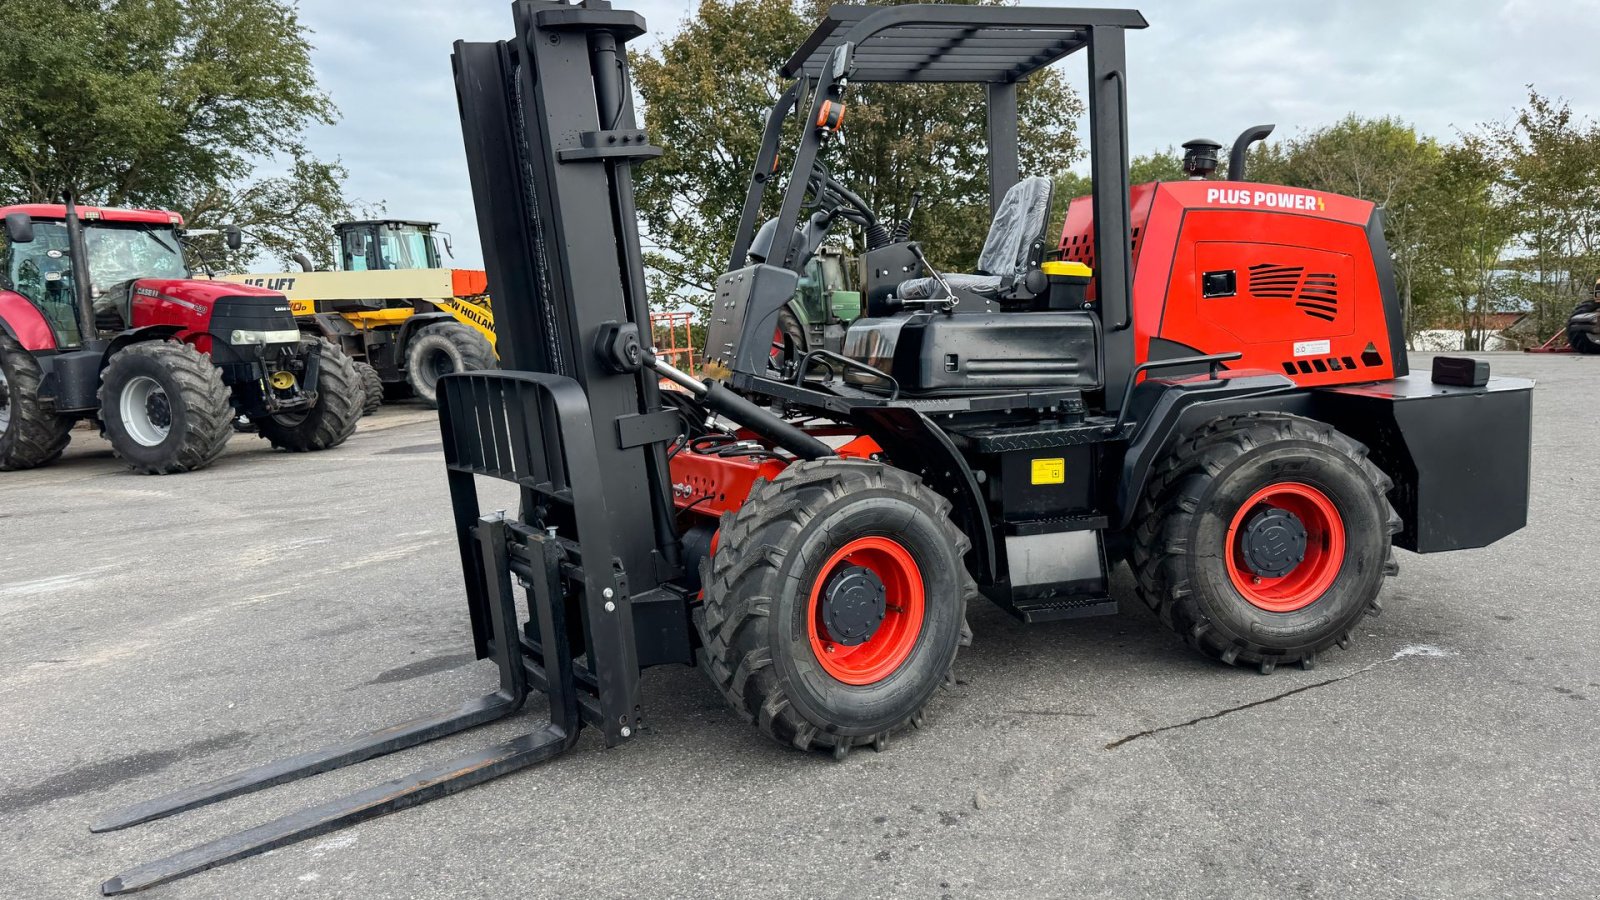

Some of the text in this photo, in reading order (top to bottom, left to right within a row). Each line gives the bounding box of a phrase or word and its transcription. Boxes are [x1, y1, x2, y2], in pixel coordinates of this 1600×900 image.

[1207, 188, 1316, 210] PLUS POWER
[267, 277, 295, 290] LIFT
[460, 306, 496, 332] HOLLAN
